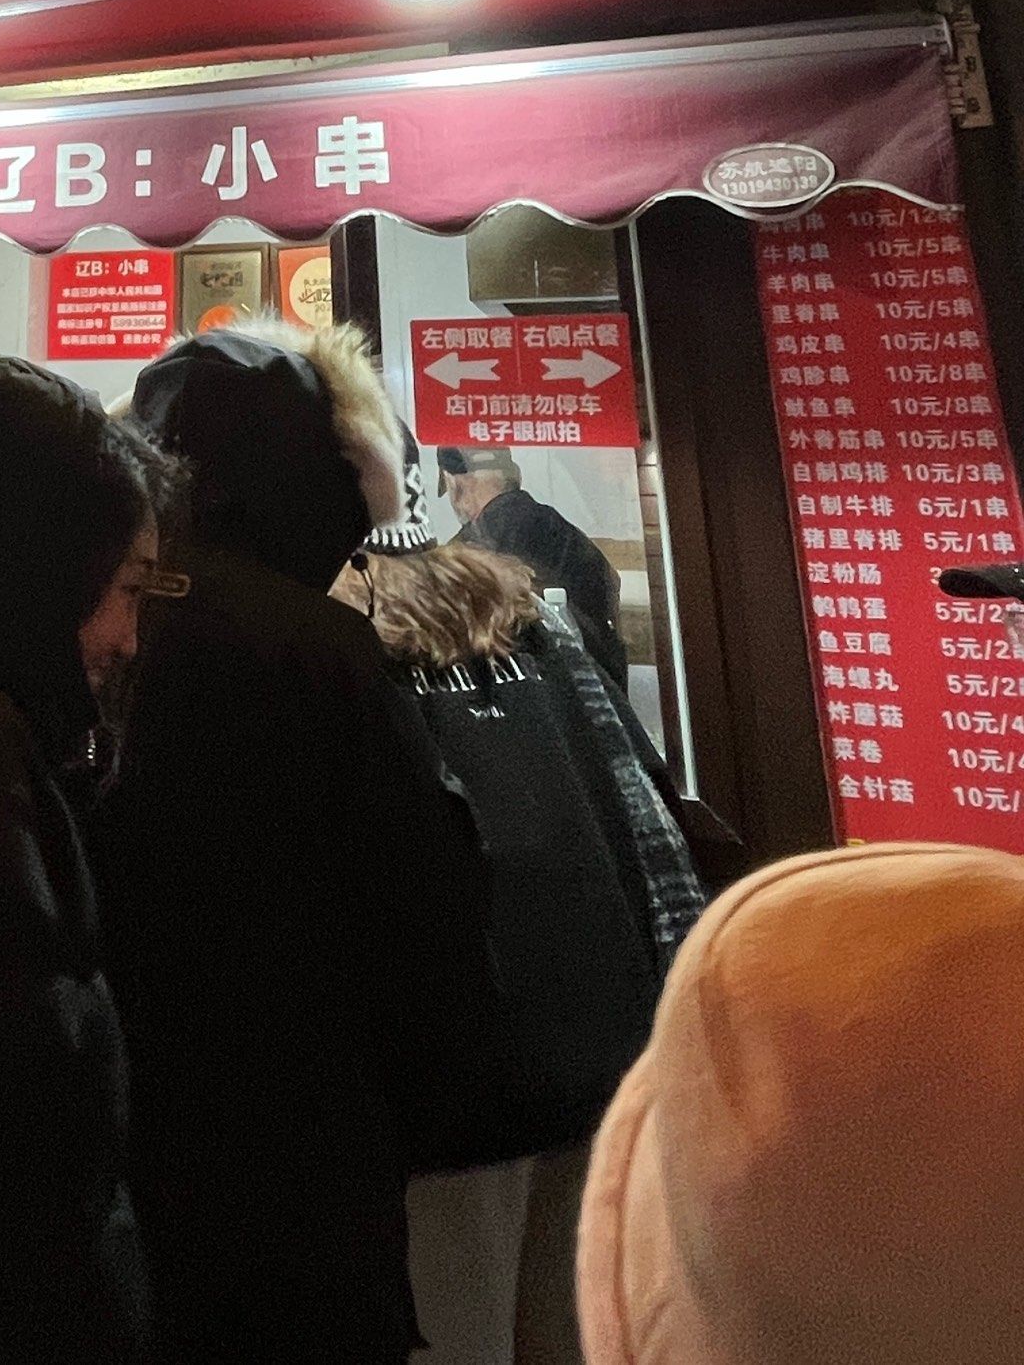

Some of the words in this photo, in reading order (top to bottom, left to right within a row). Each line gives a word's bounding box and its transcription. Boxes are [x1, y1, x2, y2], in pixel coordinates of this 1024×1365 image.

[768, 273, 836, 294] 羊肉串
[871, 266, 969, 290] 10元/5串
[772, 303, 841, 324] 里脊串
[877, 297, 975, 319] 10元/5串
[421, 326, 513, 350] 左侧取餐
[523, 323, 620, 348] 右侧点餐
[776, 334, 846, 355] 鸡皮串
[882, 328, 981, 351] 10元/4串
[886, 361, 987, 384] 10元/8串
[445, 394, 603, 417] 店门前请勿停车
[891, 394, 994, 417] 10元/8串
[468, 420, 582, 444] 电子眼抓拍
[896, 428, 999, 451] 10元/5串
[793, 461, 890, 484] 自制鸡排
[902, 461, 1006, 485] 10元/3串
[797, 494, 895, 517] 自制牛排
[918, 496, 1010, 520] 6元/1串
[923, 531, 1017, 555] 5元/1串
[807, 561, 882, 585] 淀粉肠
[818, 630, 892, 656] 鱼豆腐
[822, 664, 900, 692] 海螺丸
[946, 673, 1024, 698] 5元/2
[827, 700, 904, 729] 炸蘑菇
[832, 736, 883, 764] 菜卷
[838, 774, 914, 804] 金针菇
